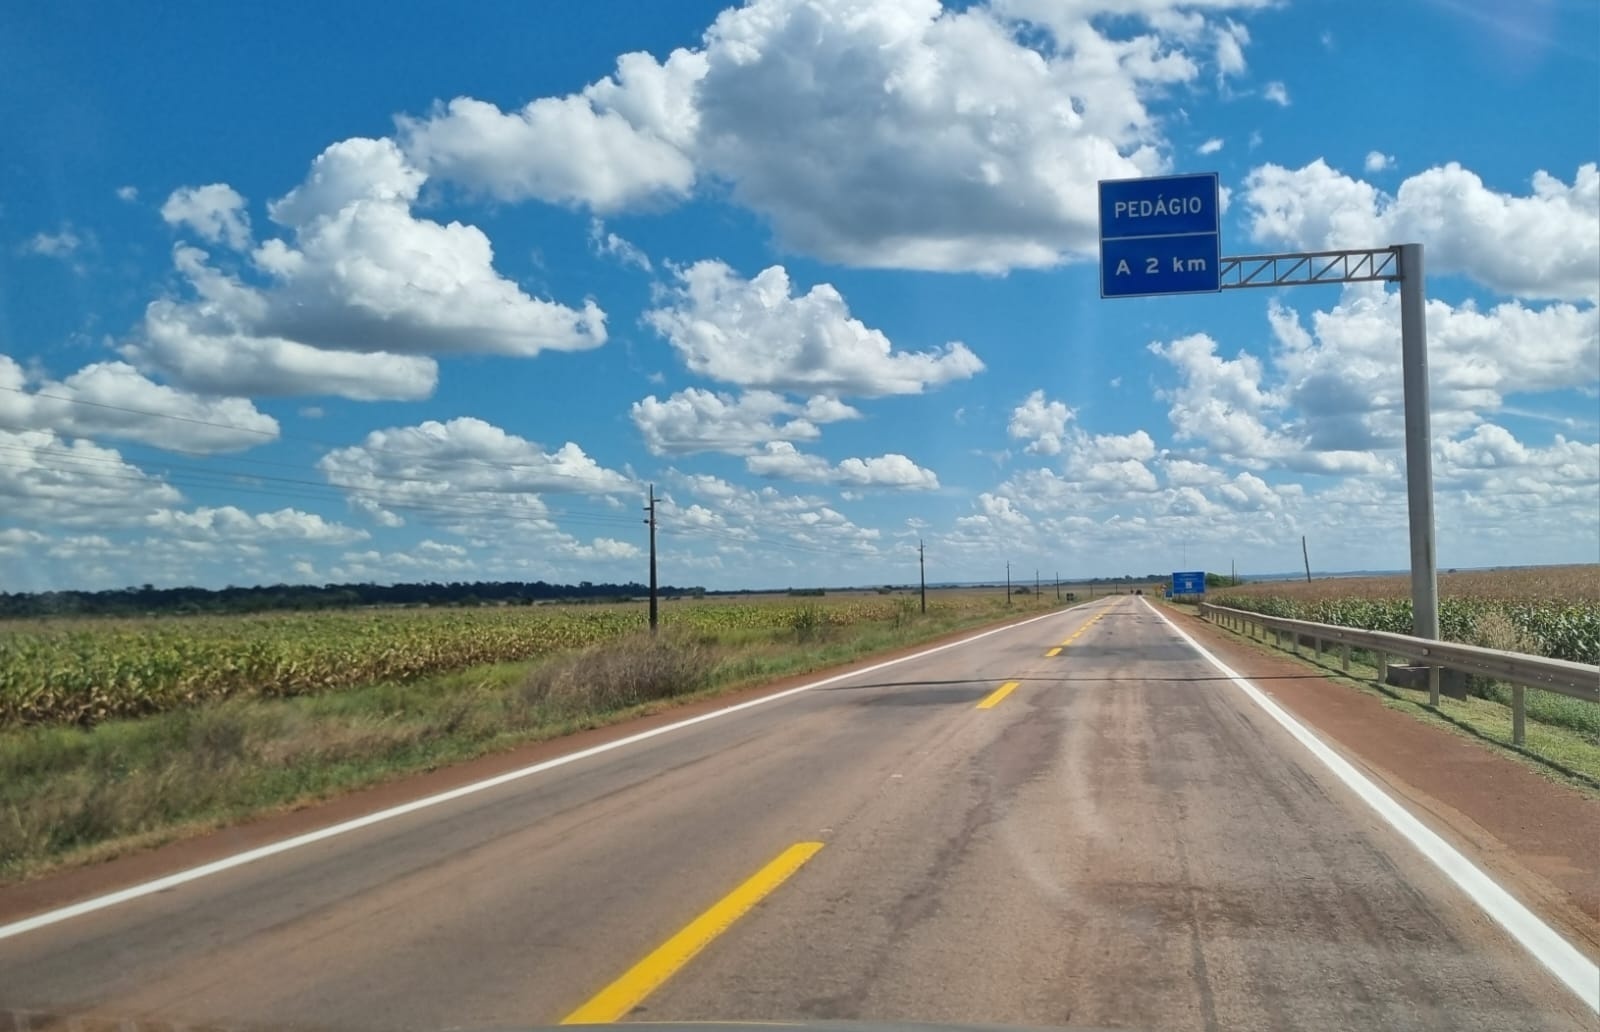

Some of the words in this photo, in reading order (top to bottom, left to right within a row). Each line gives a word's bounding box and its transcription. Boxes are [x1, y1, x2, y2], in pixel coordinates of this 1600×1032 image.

[1114, 193, 1202, 218] PEDÁGIO
[1115, 259, 1131, 276] A
[1145, 257, 1160, 274] 2
[1173, 256, 1206, 272] km
